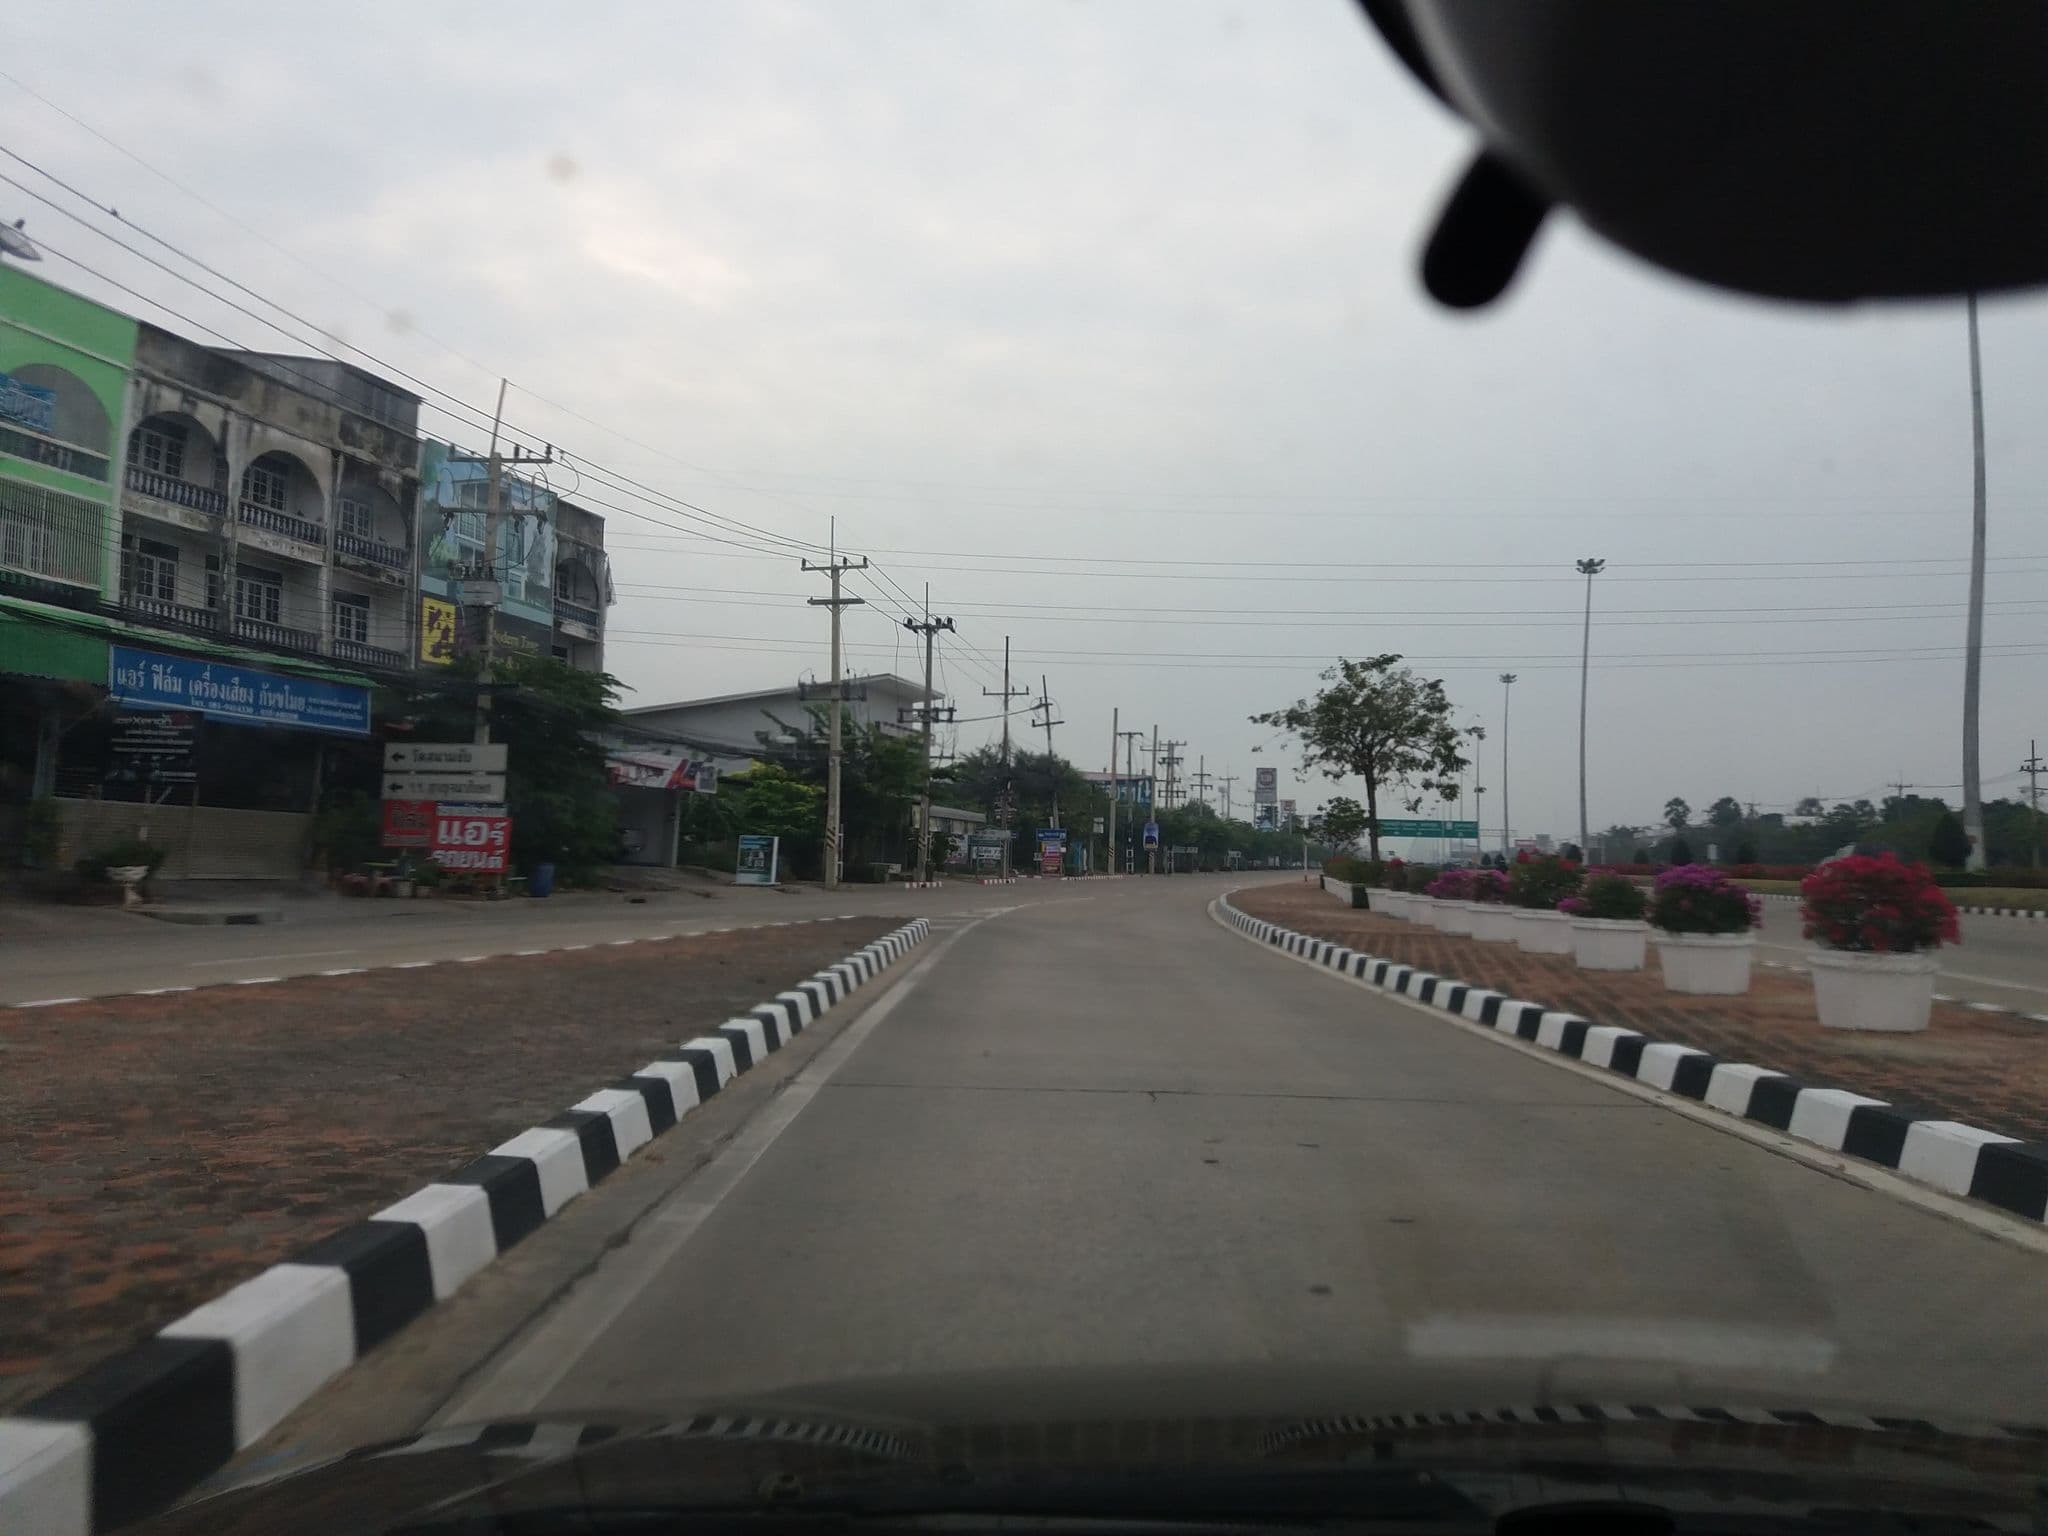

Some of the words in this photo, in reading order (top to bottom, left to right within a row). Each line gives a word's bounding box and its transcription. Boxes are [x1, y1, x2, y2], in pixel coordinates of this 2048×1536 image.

[116, 660, 146, 689] แอร์
[151, 662, 183, 695] ฟิล์ม
[188, 664, 255, 704] เครื่องเสียง
[437, 820, 508, 847] แอร์
[431, 848, 507, 869] รถยนต์
